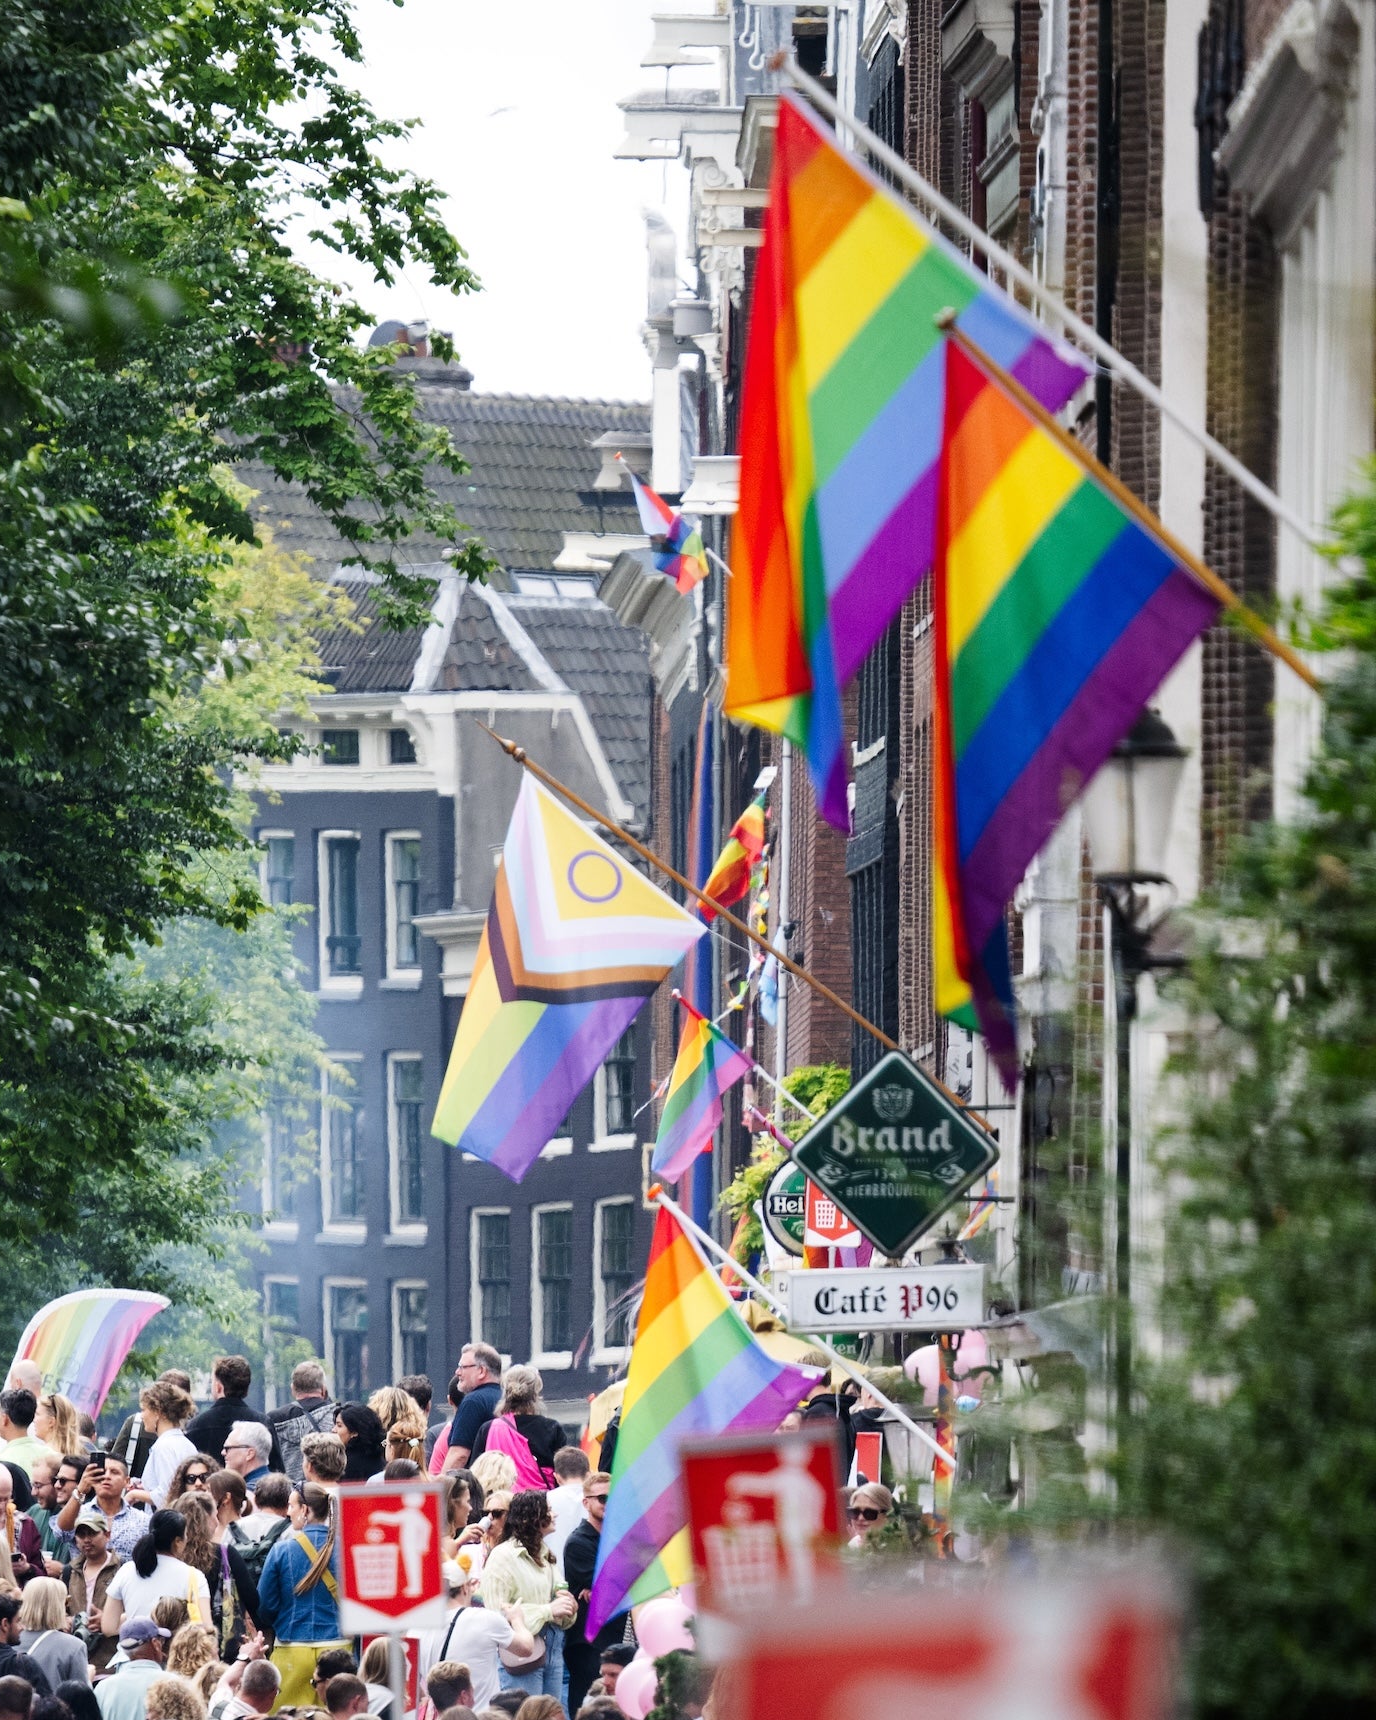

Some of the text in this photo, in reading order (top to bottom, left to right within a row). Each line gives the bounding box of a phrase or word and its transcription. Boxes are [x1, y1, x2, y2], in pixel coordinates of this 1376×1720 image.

[831, 1116, 953, 1156] Brand
[773, 1196, 805, 1214] Hei
[814, 1284, 959, 1319] Café P96
